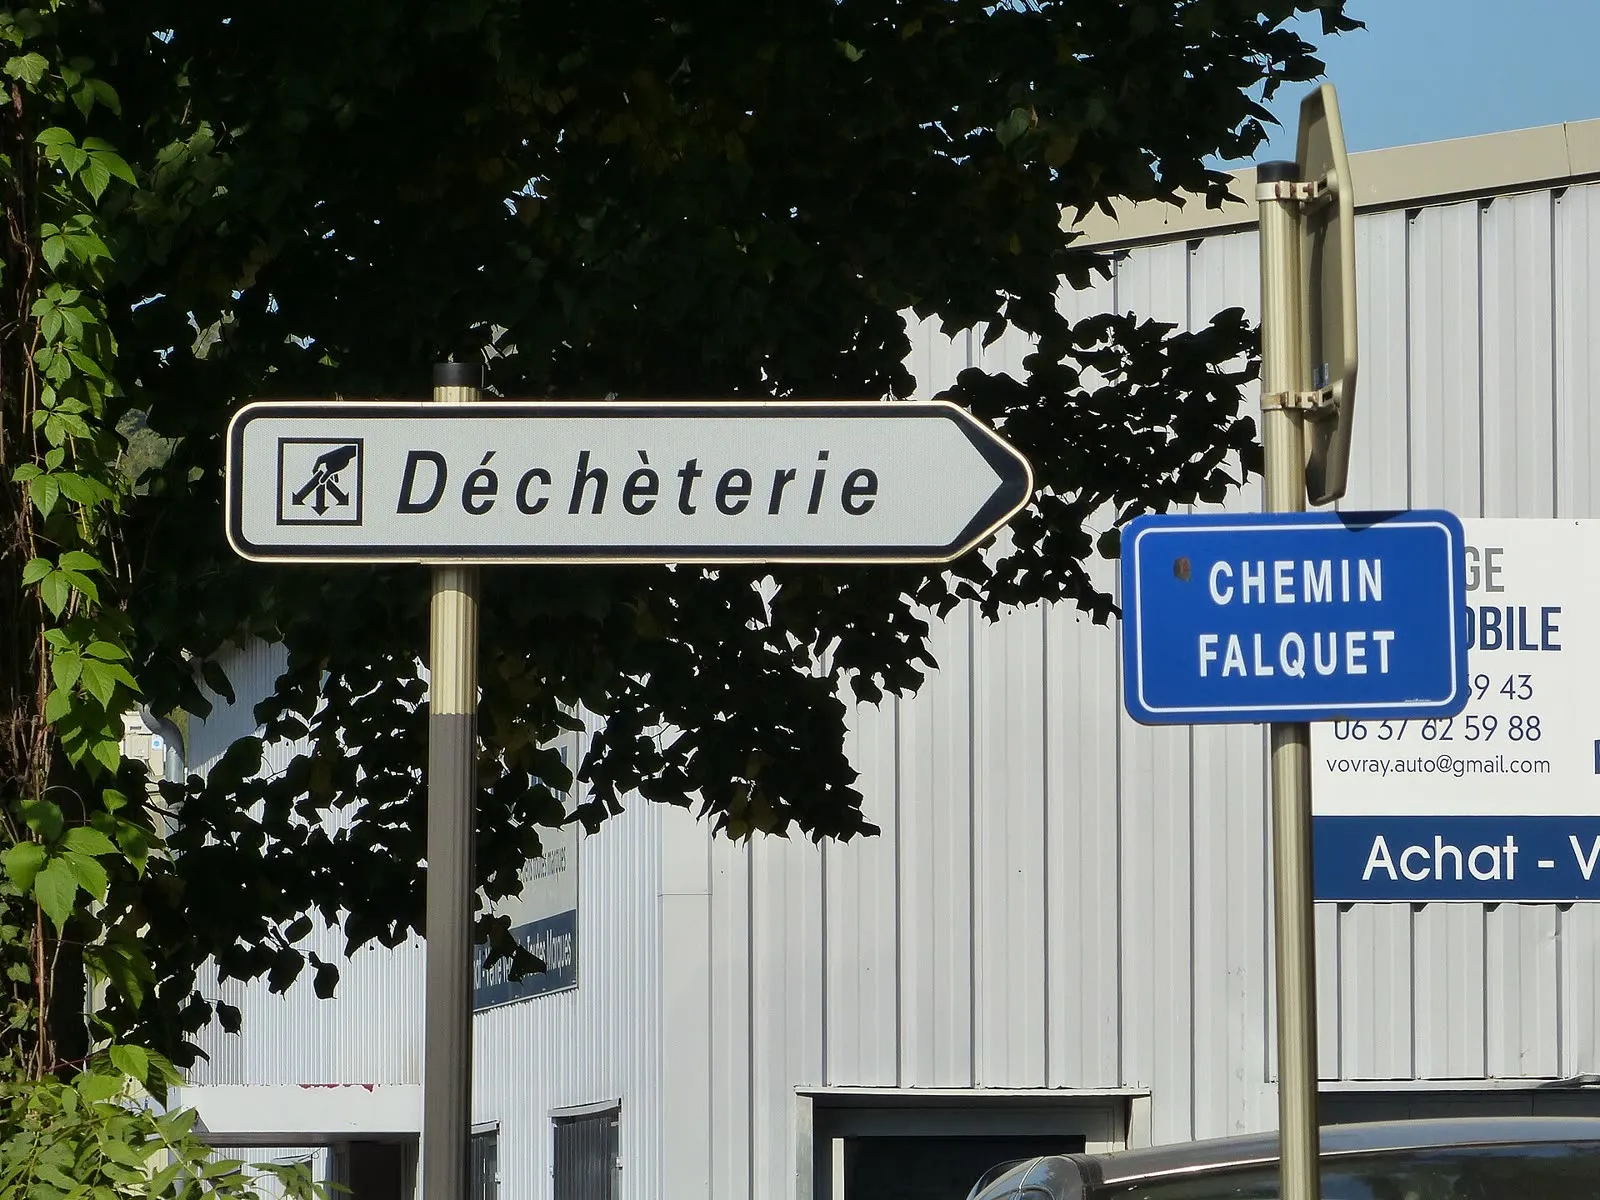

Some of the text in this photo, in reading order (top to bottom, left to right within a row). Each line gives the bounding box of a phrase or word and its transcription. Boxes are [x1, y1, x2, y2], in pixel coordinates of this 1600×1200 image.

[396, 450, 878, 516] Déchèterie
[1208, 558, 1382, 606] CHEMIN
[1199, 630, 1395, 679] FALQUET
[1499, 674, 1533, 701] 43
[1334, 719, 1368, 742] 06
[1421, 717, 1454, 742] 62
[1464, 716, 1498, 742] 59
[1508, 715, 1542, 742] 88
[1326, 754, 1550, 778] vovray.auto@gmail.com
[1362, 835, 1519, 882] Achat
